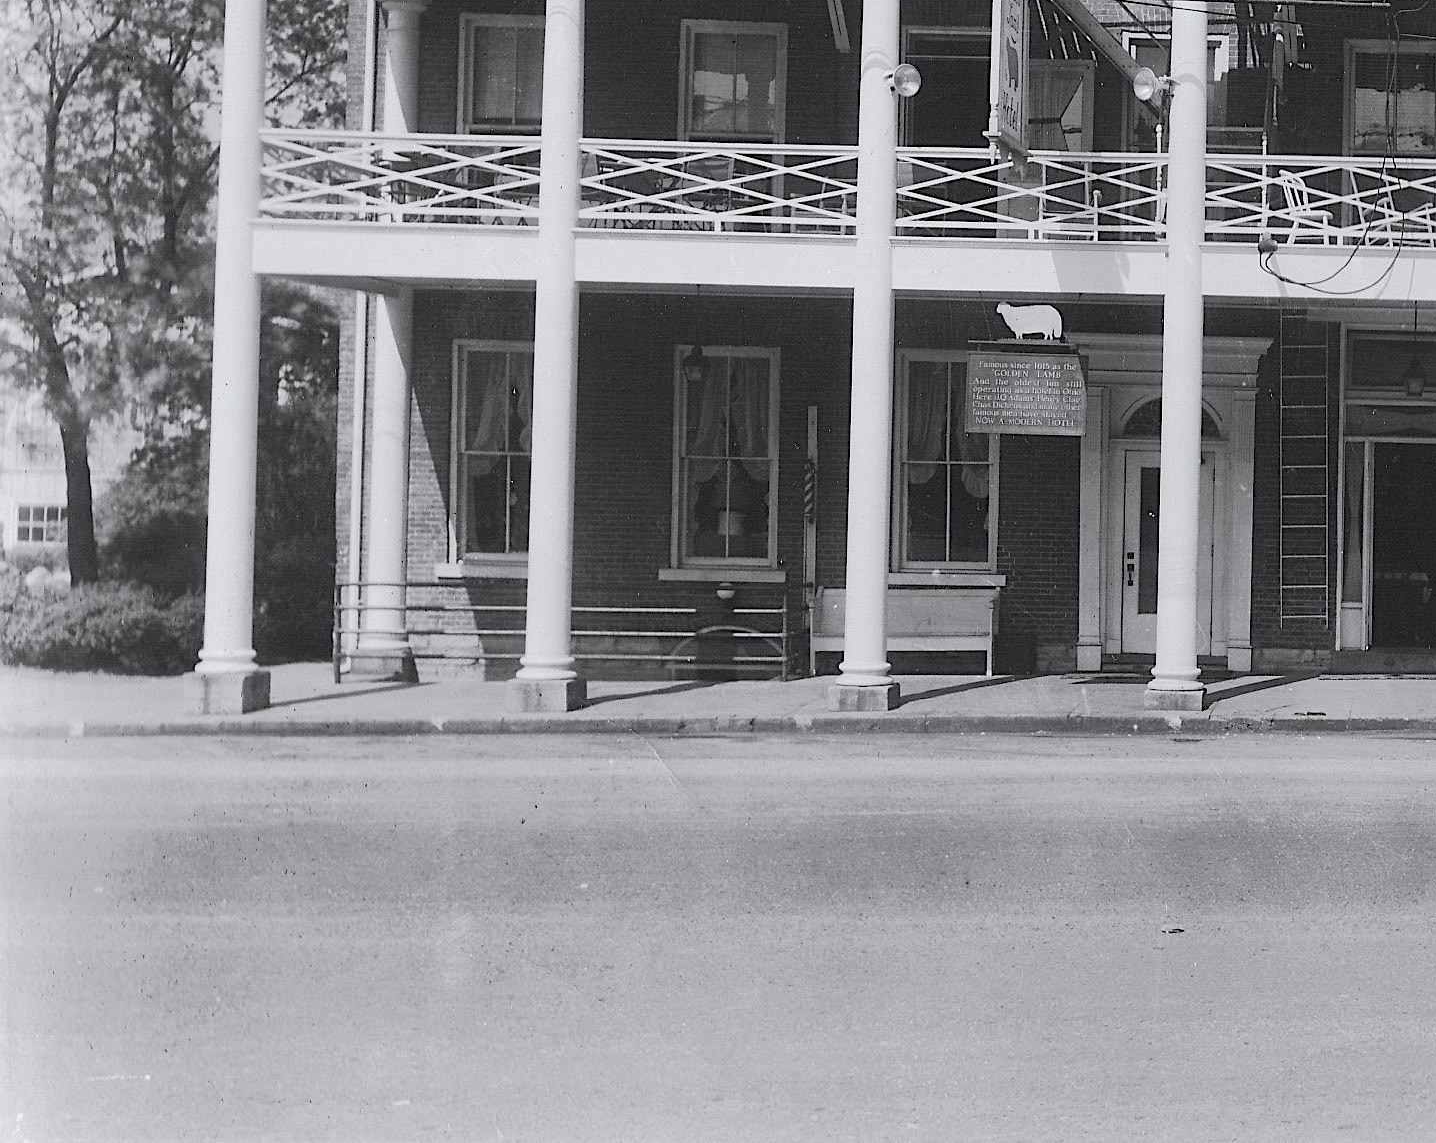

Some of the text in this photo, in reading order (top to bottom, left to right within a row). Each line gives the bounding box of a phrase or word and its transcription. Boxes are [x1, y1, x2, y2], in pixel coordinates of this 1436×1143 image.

[1010, 361, 1031, 369] since
[1034, 362, 1050, 370] 1815
[1063, 362, 1077, 371] the
[972, 377, 990, 385] And
[995, 378, 1009, 386] the
[1066, 380, 1082, 388] still
[972, 387, 1012, 395] operating
[1032, 387, 1051, 395] hotel
[972, 409, 1000, 417] famous
[1020, 410, 1039, 418] have
[975, 417, 995, 425] NOW
[998, 417, 1005, 425] A
[1008, 418, 1043, 426] MODERN
